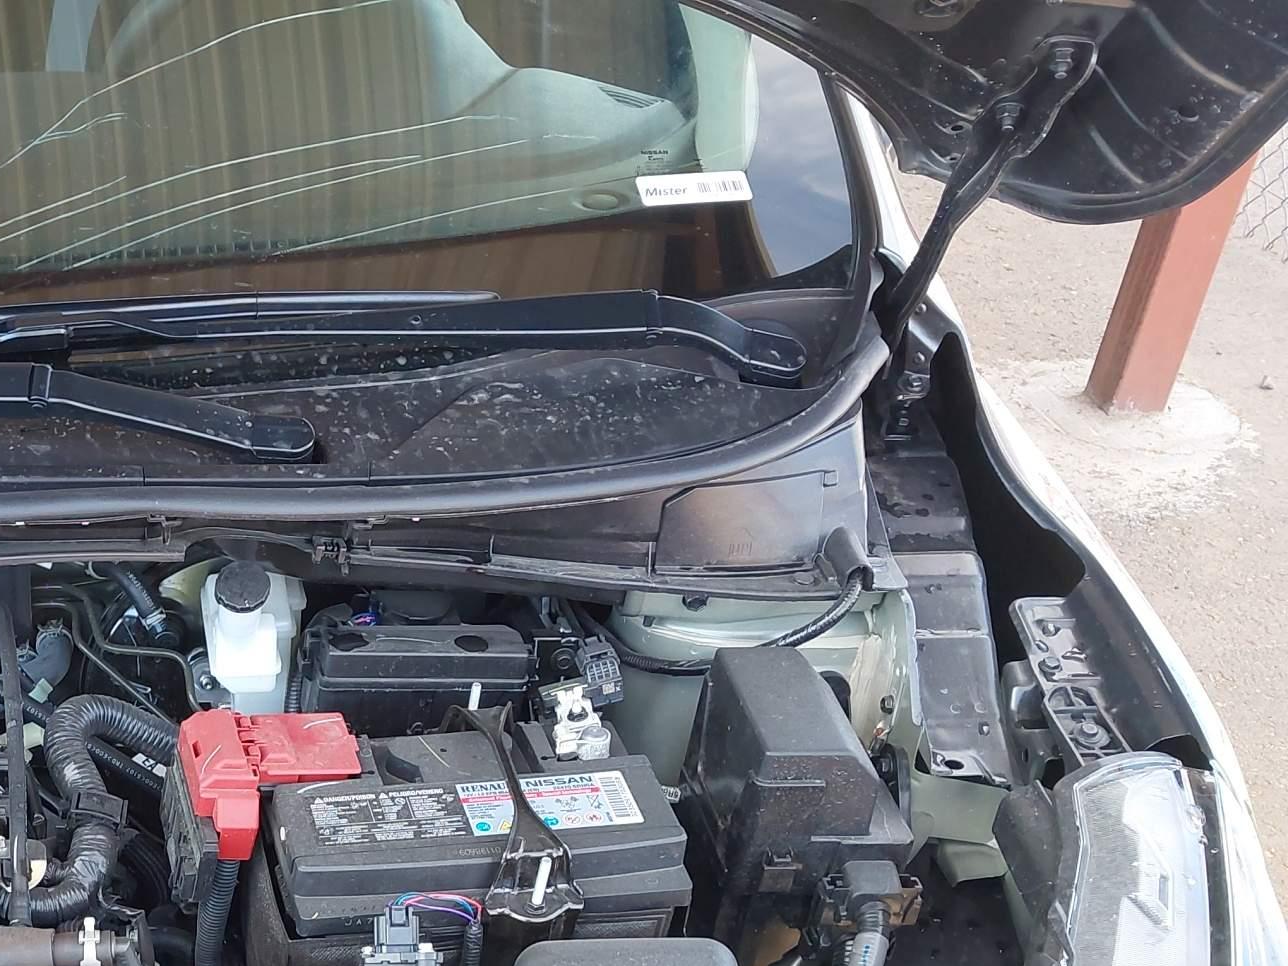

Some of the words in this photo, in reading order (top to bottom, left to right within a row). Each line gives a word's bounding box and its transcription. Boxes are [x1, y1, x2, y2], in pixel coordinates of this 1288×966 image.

[645, 186, 688, 198] Mister
[461, 782, 506, 793] RENAU
[525, 775, 592, 788] NISSAN
